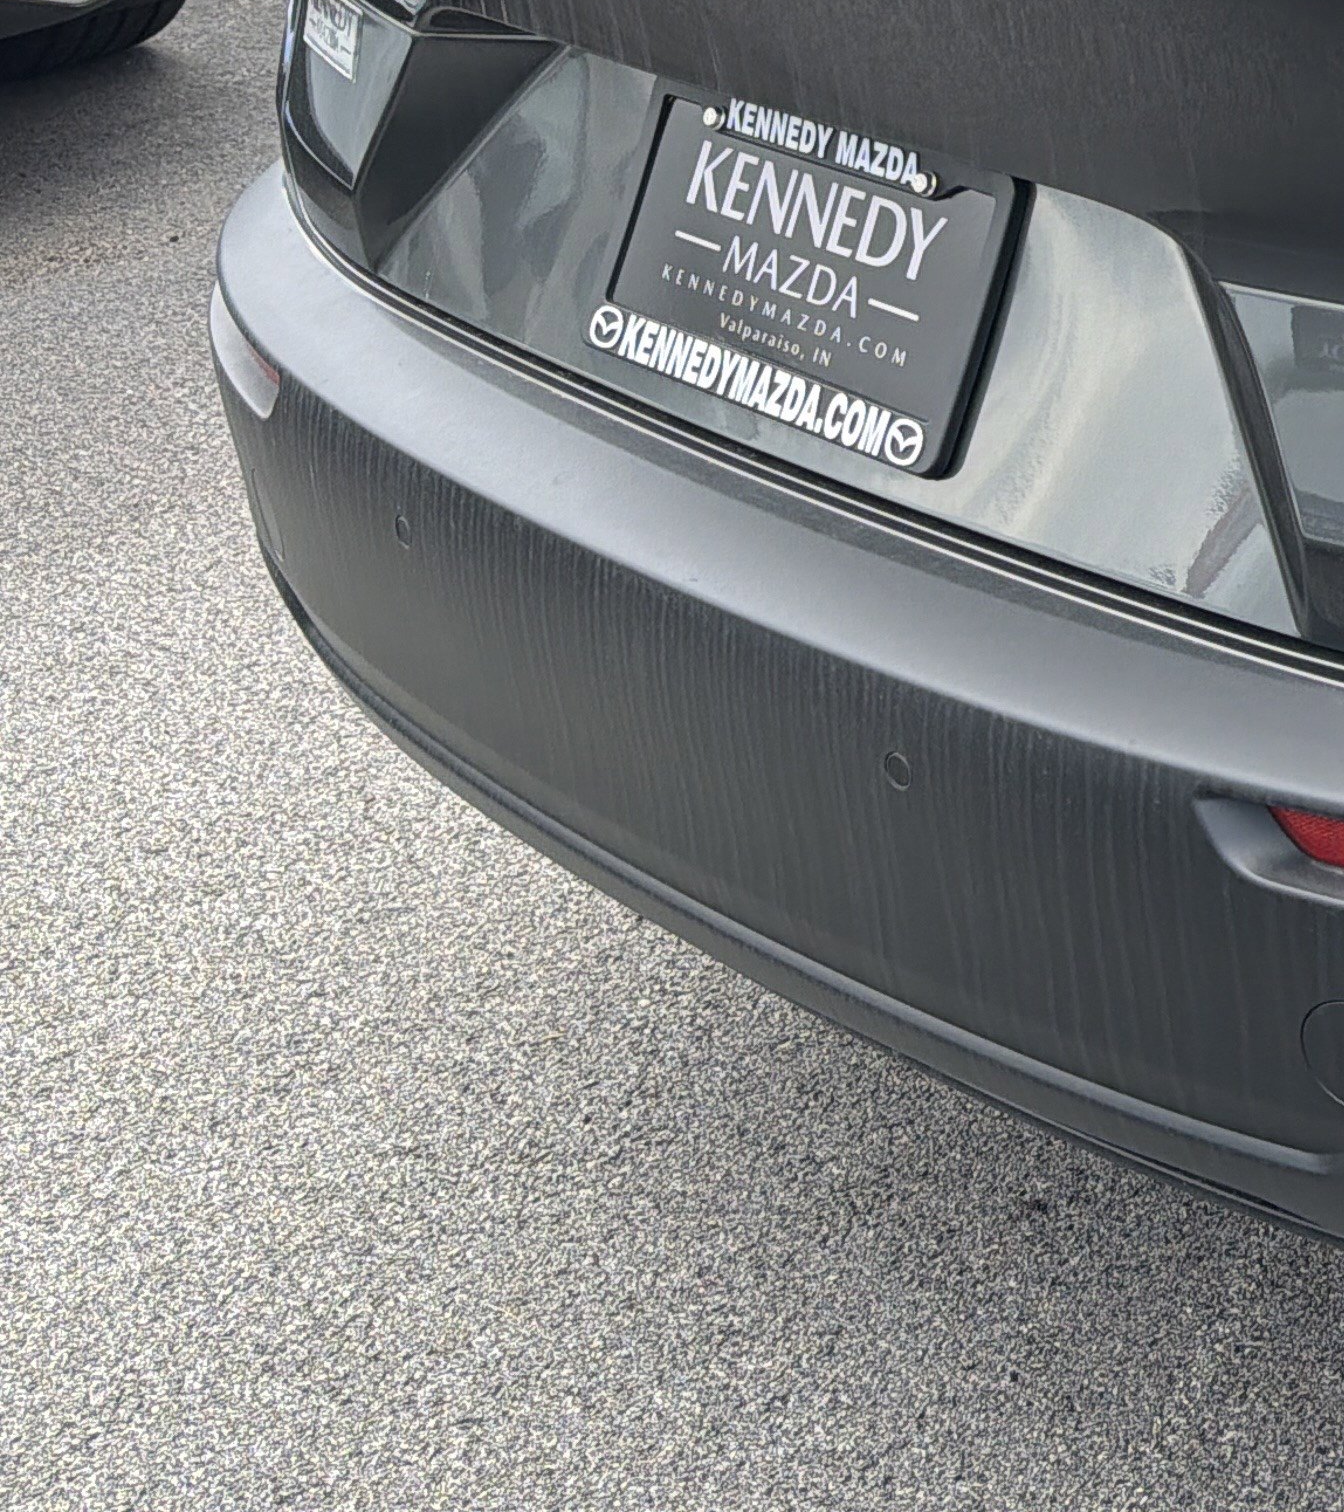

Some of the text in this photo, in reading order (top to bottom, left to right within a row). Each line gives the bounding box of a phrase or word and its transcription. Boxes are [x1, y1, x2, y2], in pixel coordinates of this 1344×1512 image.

[726, 97, 918, 185] KENNEDY MAZDA
[685, 140, 949, 282] KENNEDY
[661, 262, 908, 367] KENNEDYMAZDA.COM
[722, 235, 858, 319] MAZDA
[618, 316, 889, 457] KENNEDYMAZDA.COM
[719, 311, 833, 367] Valparaiso, IN
